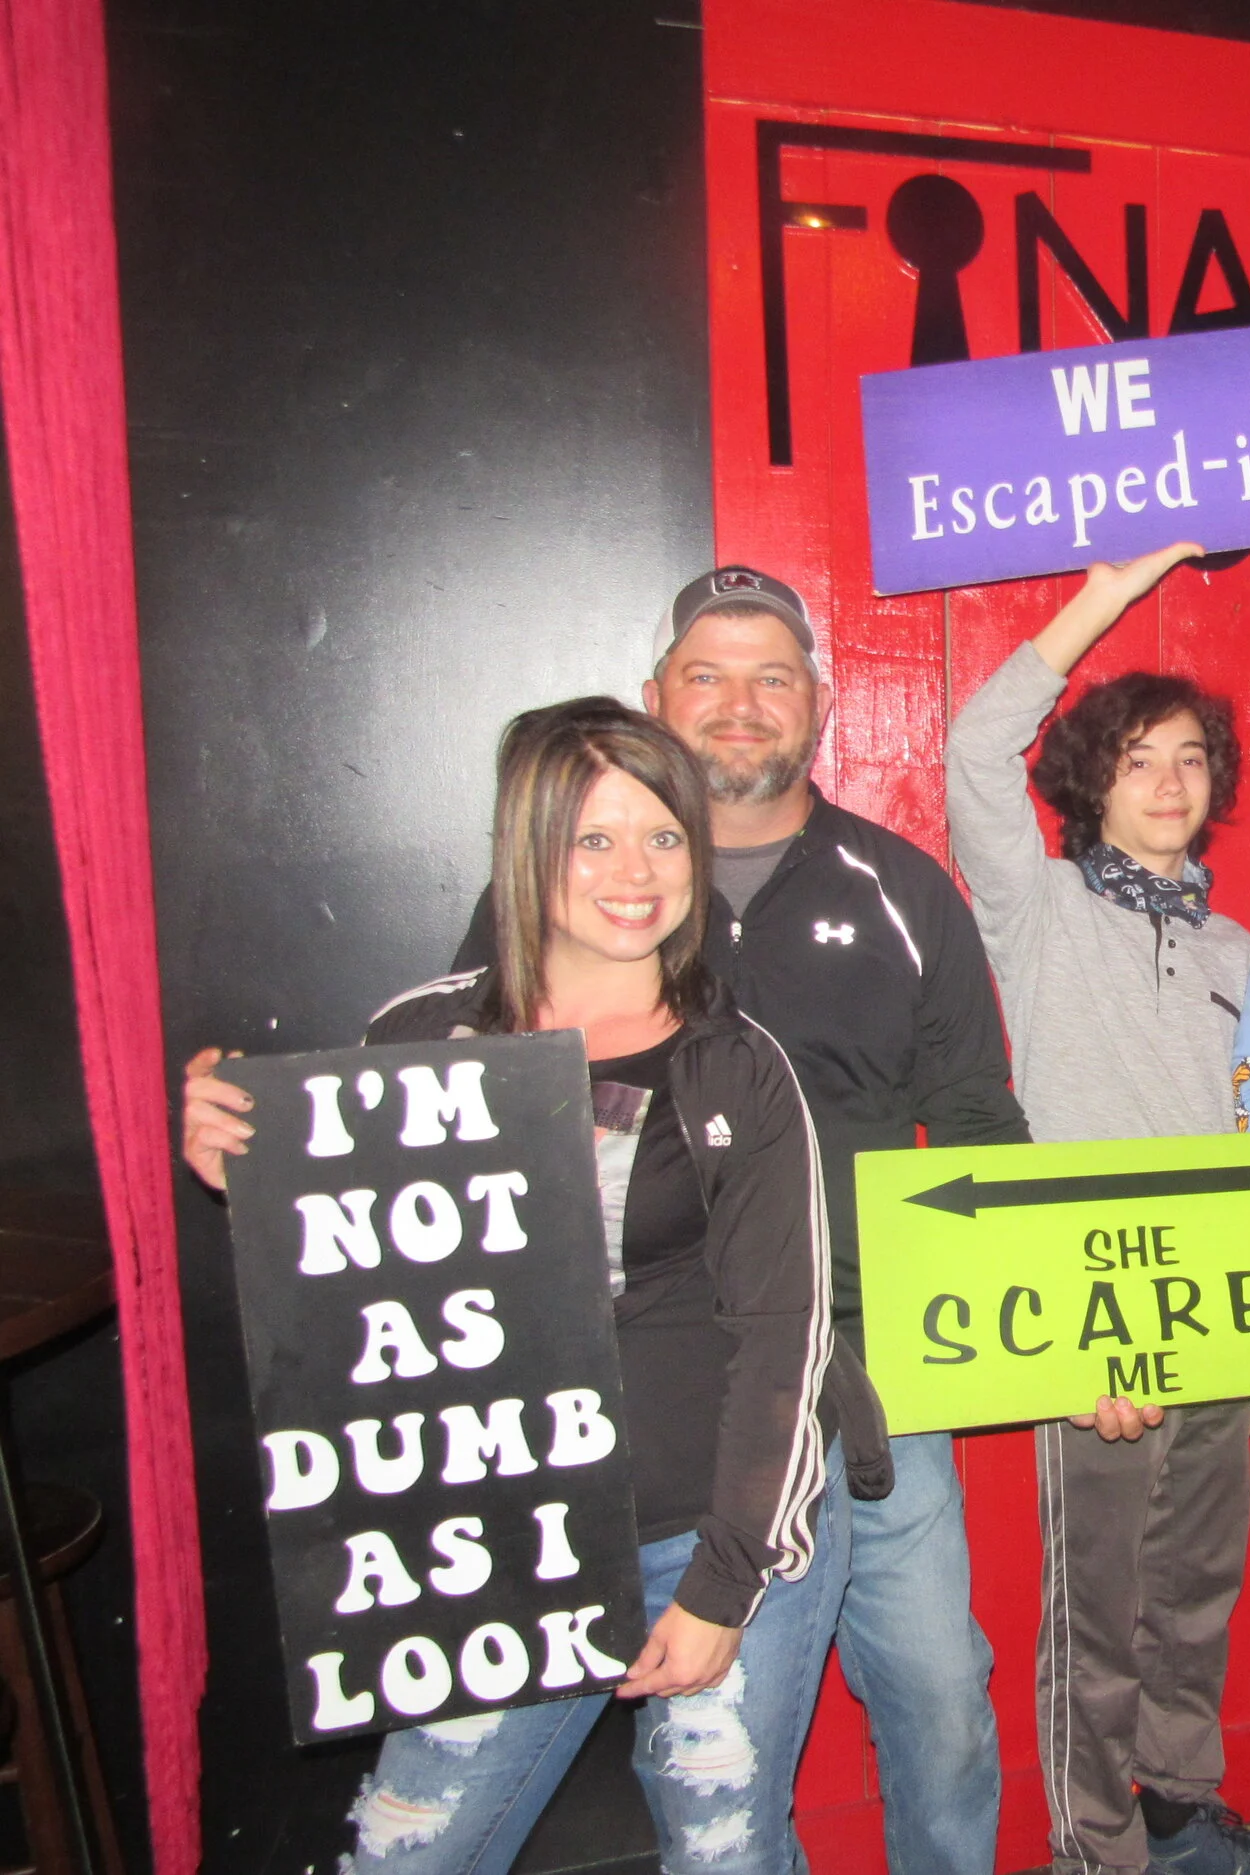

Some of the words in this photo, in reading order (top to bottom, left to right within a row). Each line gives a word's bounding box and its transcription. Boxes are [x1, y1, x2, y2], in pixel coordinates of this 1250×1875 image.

[1051, 358, 1157, 436] WE
[305, 1060, 500, 1158] I'M
[295, 1170, 529, 1276] NOT
[1083, 1225, 1181, 1272] SHE
[351, 1289, 506, 1385] AS
[1106, 1350, 1184, 1398] ME
[262, 1388, 618, 1511] DUMB
[335, 1516, 493, 1614] AS
[533, 1502, 581, 1582] I
[307, 1604, 628, 1732] LOOK
